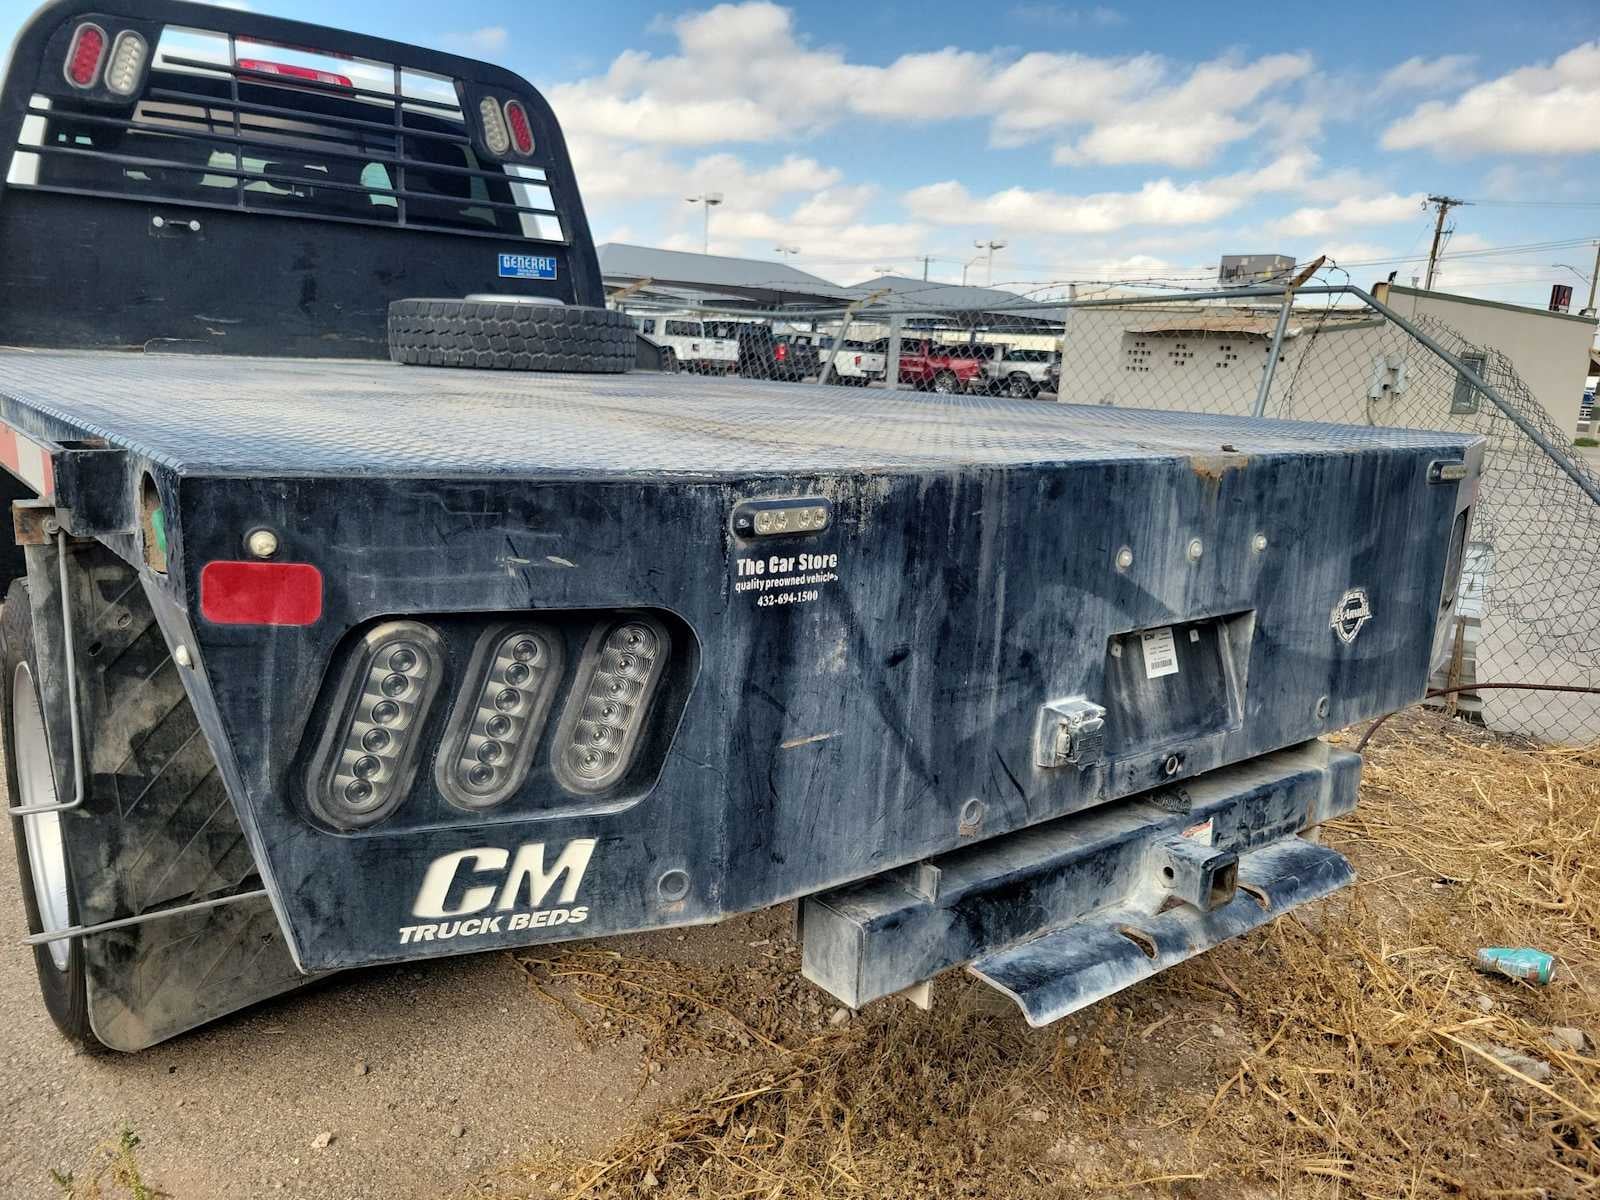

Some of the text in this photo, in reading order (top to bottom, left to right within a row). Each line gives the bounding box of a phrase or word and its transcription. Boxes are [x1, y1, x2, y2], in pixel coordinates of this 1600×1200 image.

[503, 255, 552, 271] GENERAL
[737, 553, 838, 576] The Car Store
[735, 577, 765, 593] quality
[765, 573, 806, 591] preowned
[757, 590, 818, 607] 432-694-1500
[412, 838, 598, 918] CM
[399, 906, 589, 945] TRUCK BEDS
